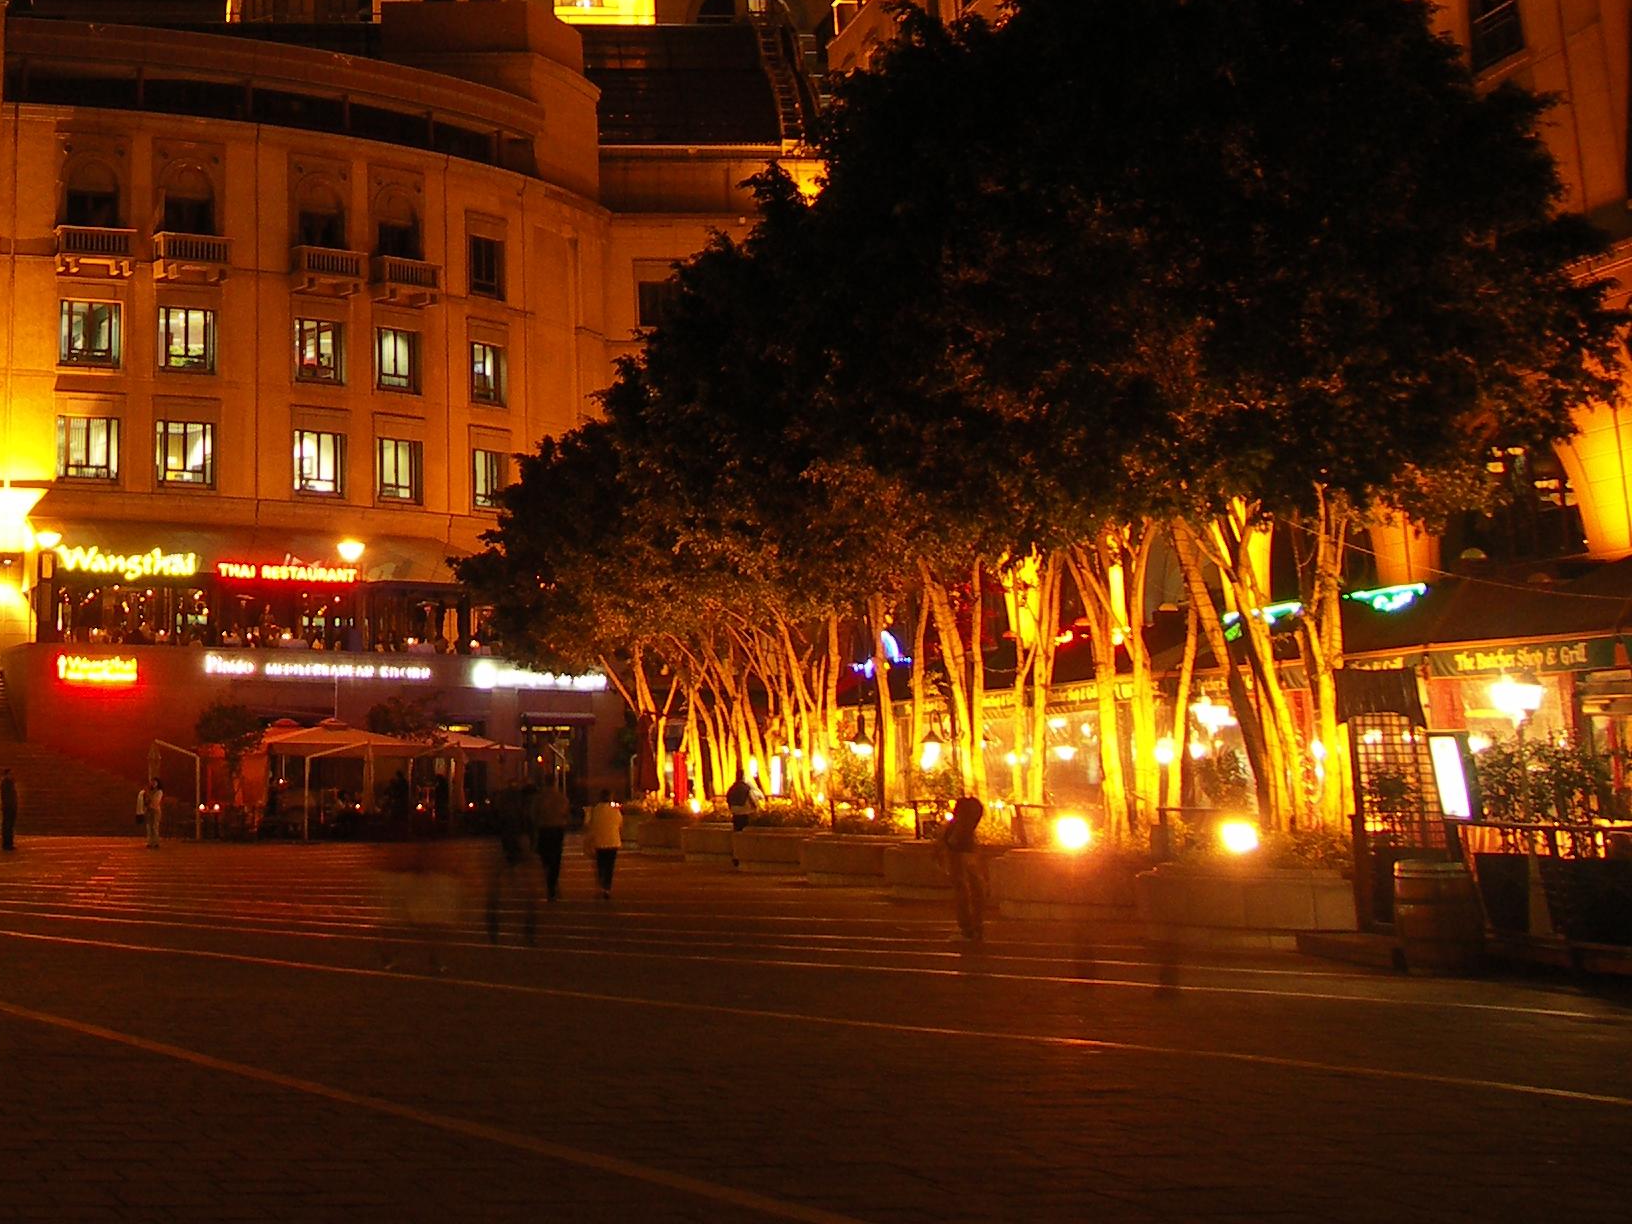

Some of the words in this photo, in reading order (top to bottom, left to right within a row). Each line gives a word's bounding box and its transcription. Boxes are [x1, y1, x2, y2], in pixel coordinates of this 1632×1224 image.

[218, 562, 257, 579] THAI
[260, 564, 359, 584] RESTAURANT
[1455, 650, 1475, 671] The
[1517, 646, 1544, 674] Shop
[1546, 647, 1558, 666] &
[1559, 642, 1589, 666] Grill
